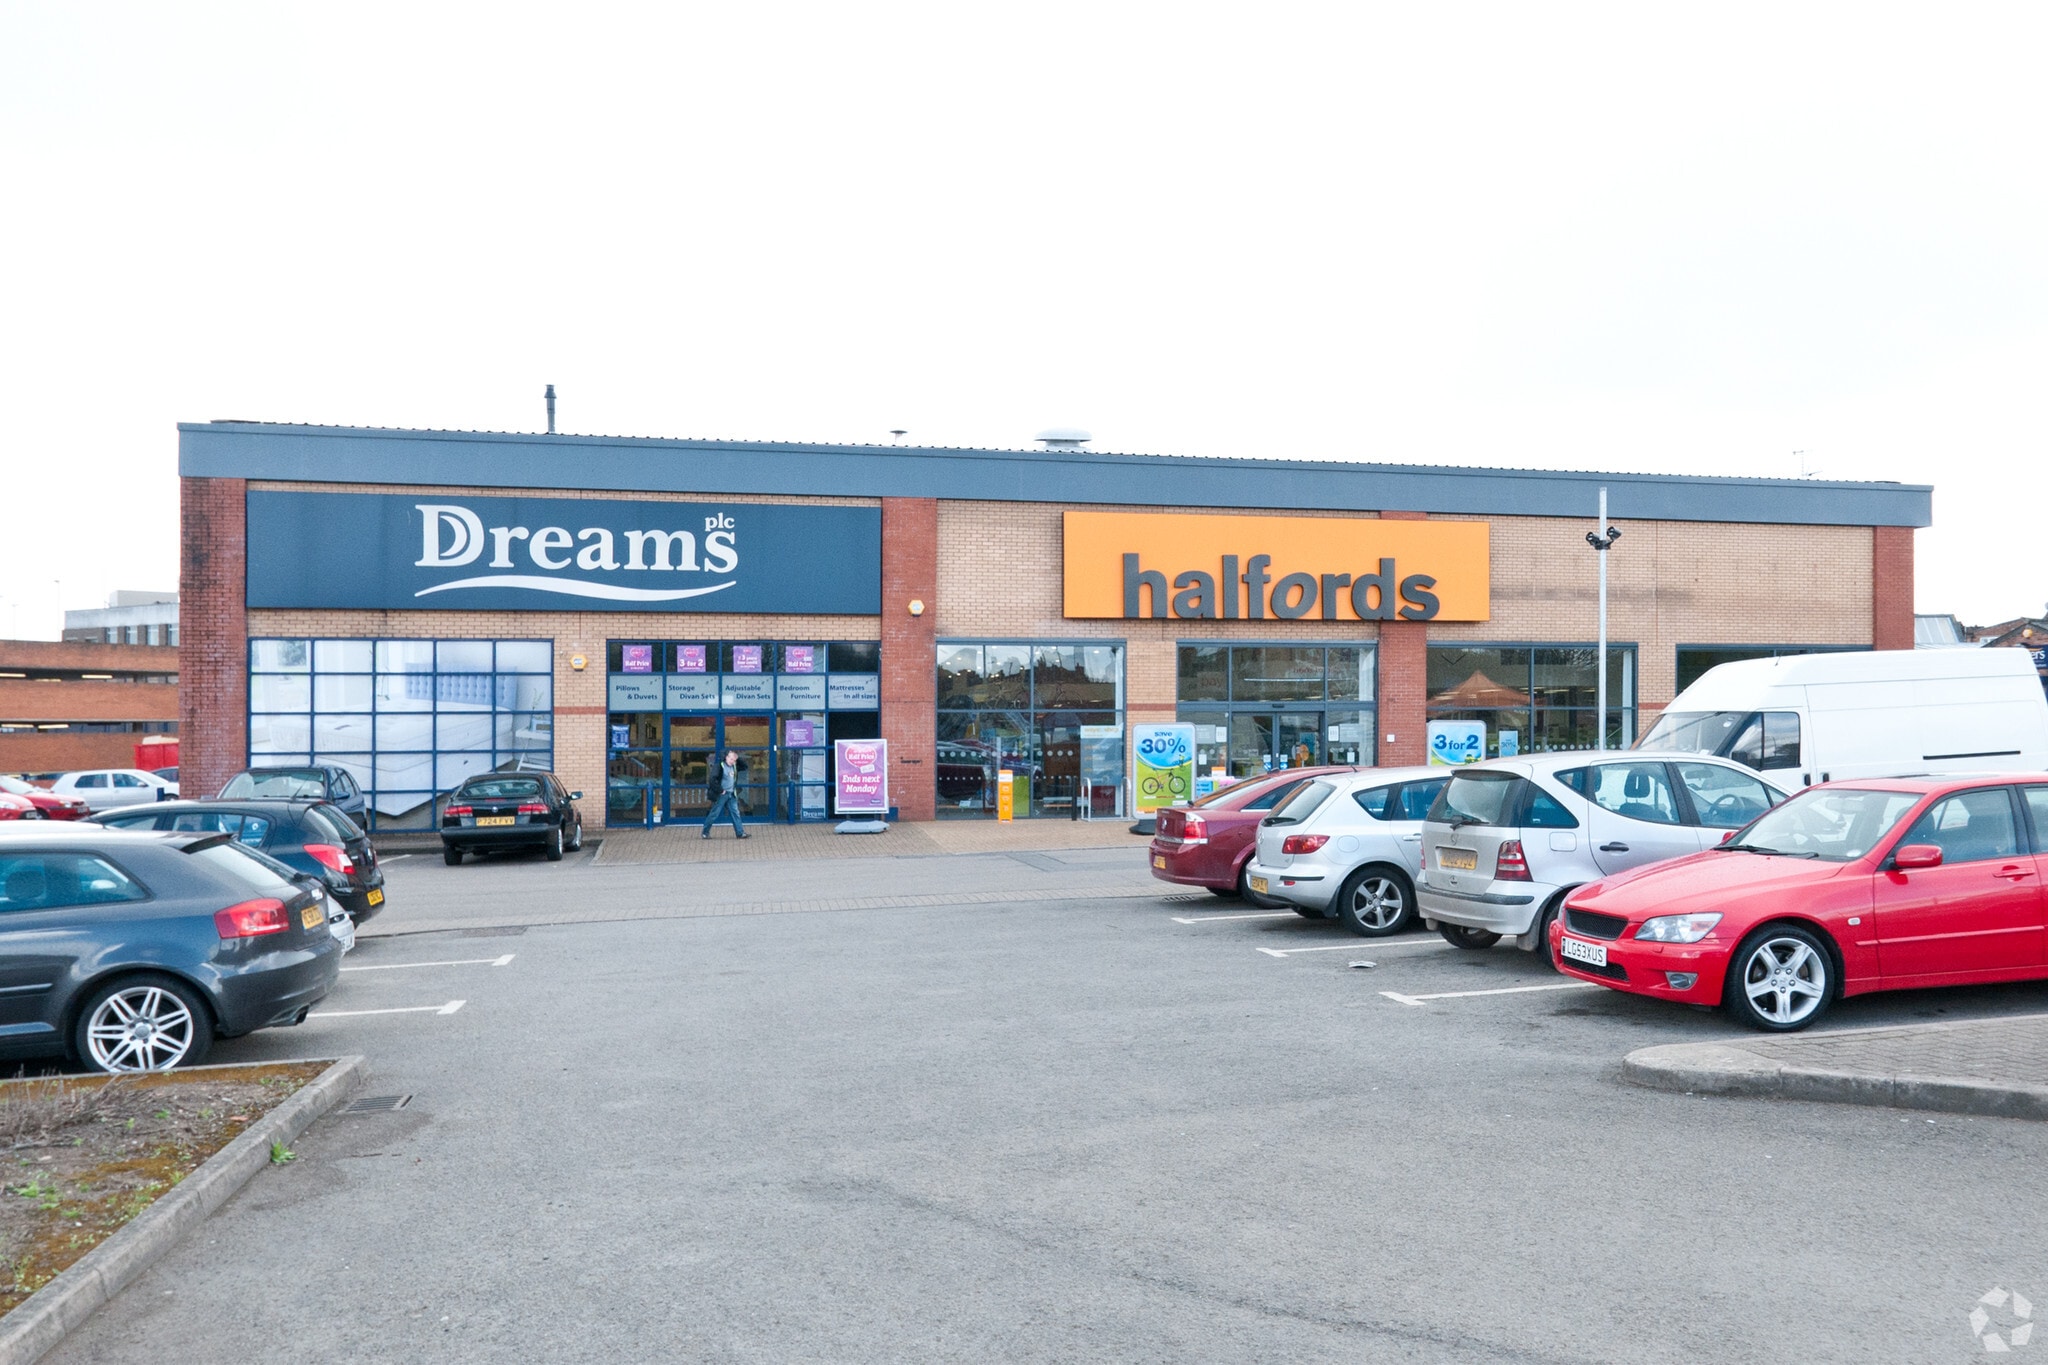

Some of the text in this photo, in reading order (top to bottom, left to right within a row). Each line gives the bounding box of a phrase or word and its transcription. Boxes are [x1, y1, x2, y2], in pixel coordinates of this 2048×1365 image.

[705, 512, 735, 532] plc
[414, 505, 738, 573] Dreams
[1122, 552, 1440, 621] halfords
[679, 658, 685, 667] 3
[697, 658, 704, 667] 2
[1141, 737, 1186, 754] 30%
[1434, 734, 1479, 750] 3 for 2
[842, 774, 880, 783] Ends next
[846, 784, 877, 795] Monday
[1567, 941, 1603, 963] LG53XUS
